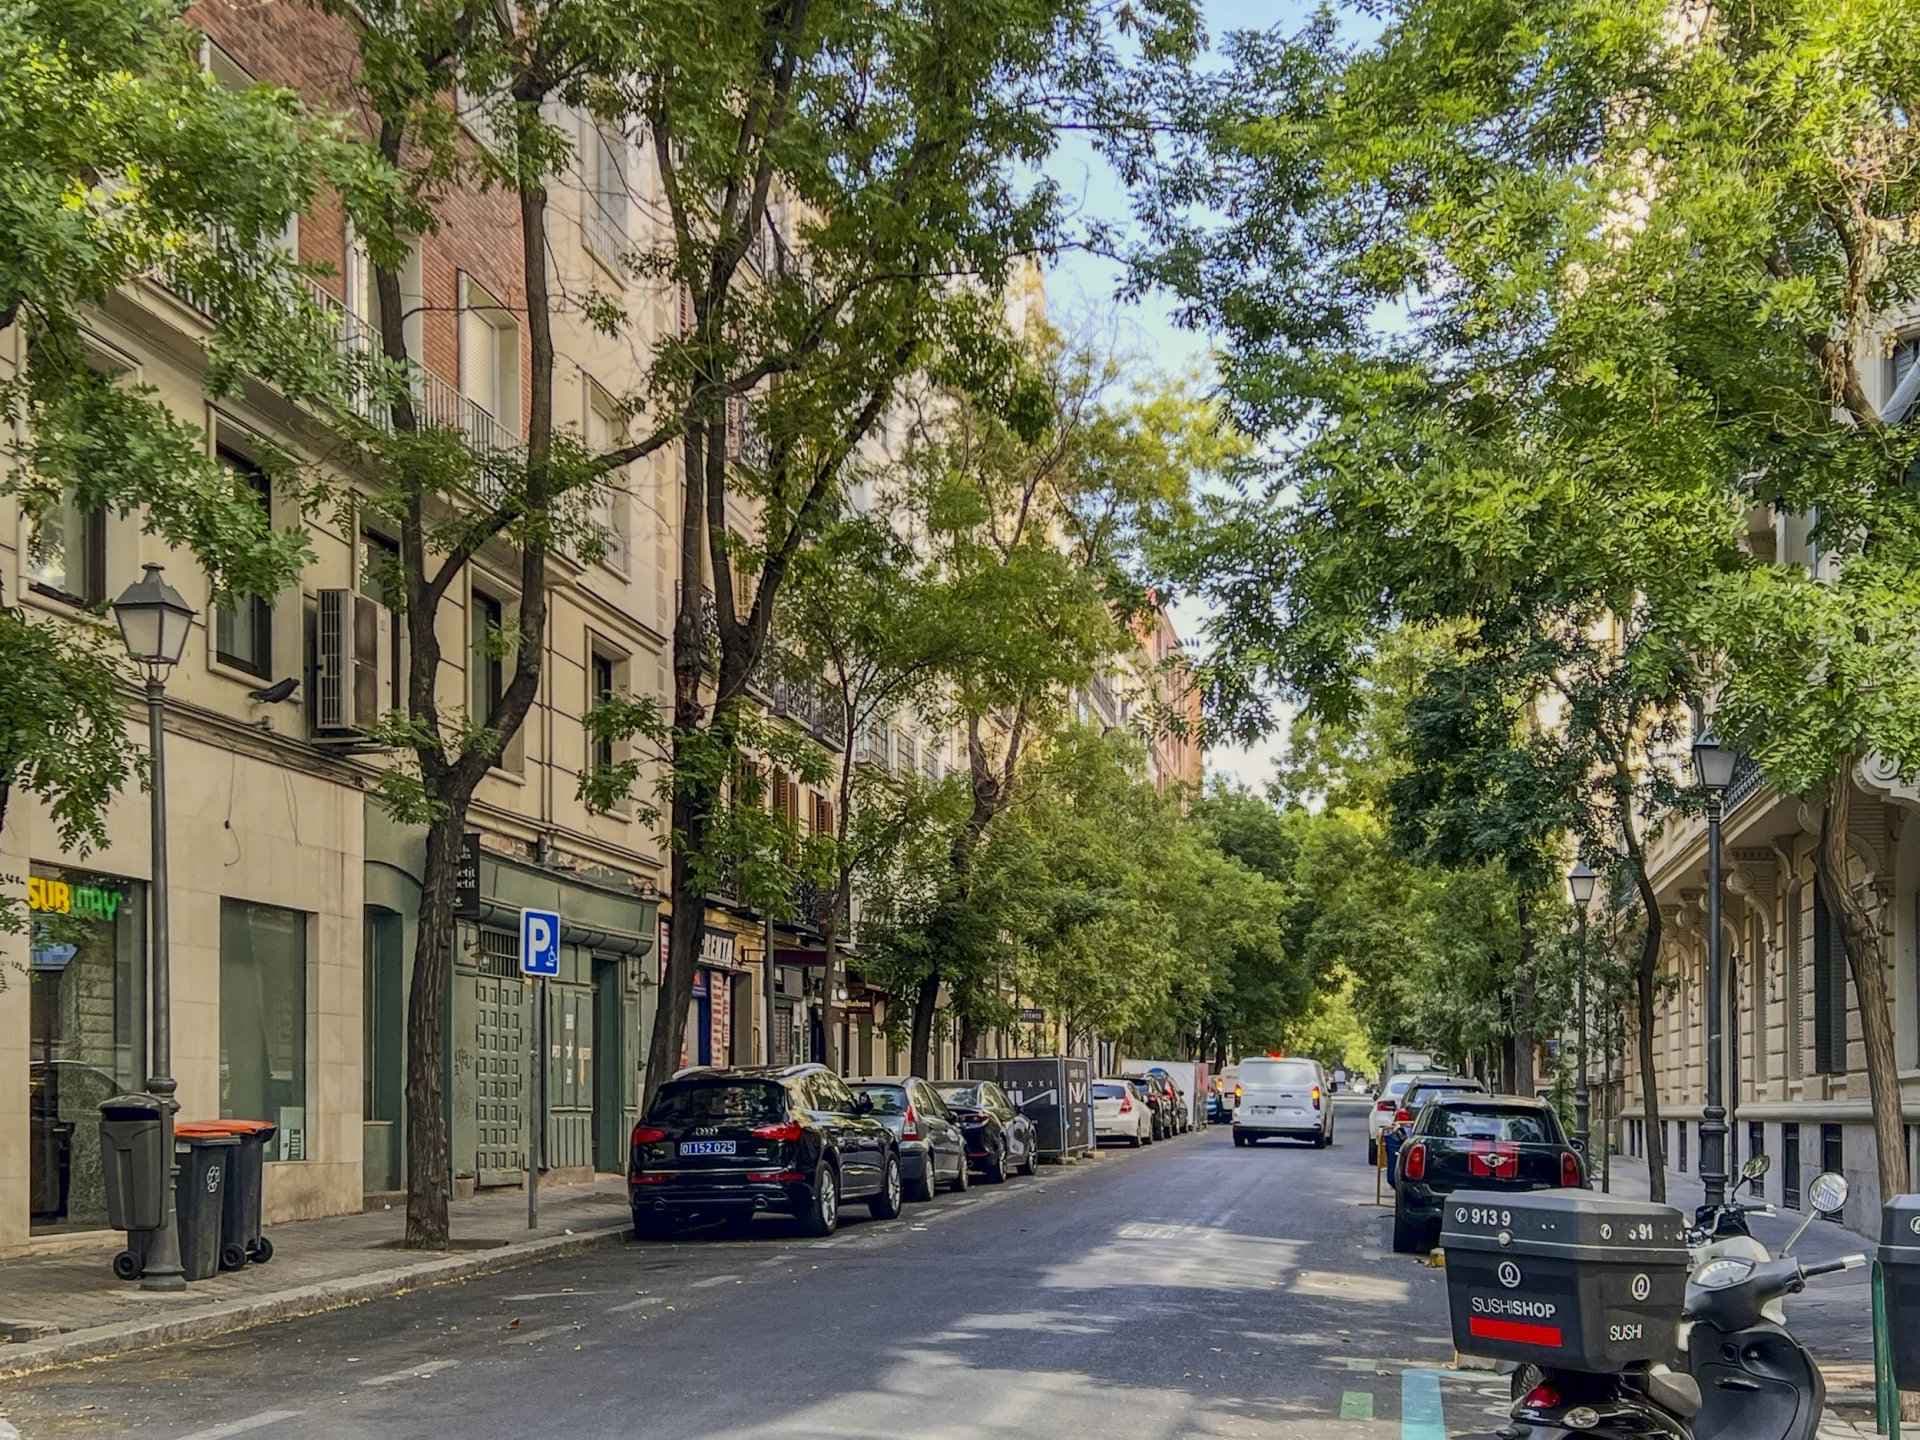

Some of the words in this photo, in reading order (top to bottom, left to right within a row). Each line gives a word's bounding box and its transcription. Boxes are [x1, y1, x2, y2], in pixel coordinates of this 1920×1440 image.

[528, 917, 551, 967] P
[701, 932, 734, 968] RENTA
[1471, 1208, 1498, 1226] 913
[1472, 1297, 1556, 1318] SUSHISHOP
[1610, 1324, 1642, 1341] SUSHI
